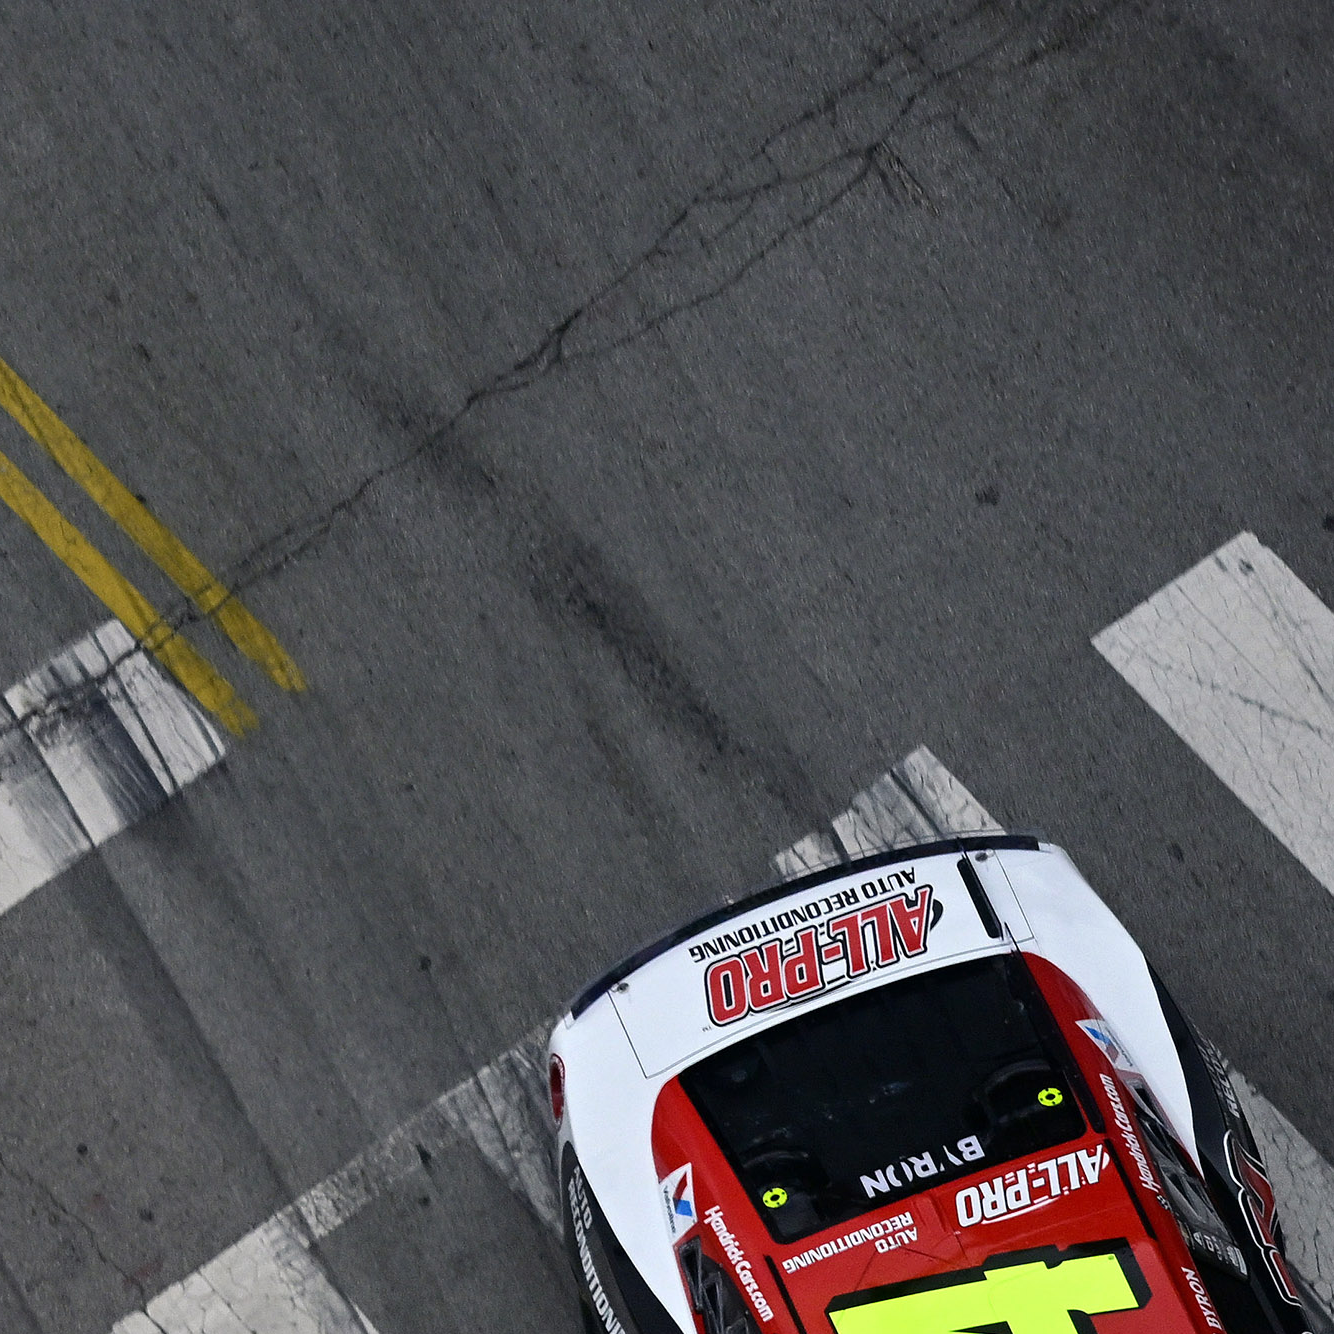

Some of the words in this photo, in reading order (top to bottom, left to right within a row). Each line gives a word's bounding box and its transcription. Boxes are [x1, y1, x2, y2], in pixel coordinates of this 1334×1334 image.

[861, 867, 916, 899] AUTO
[688, 888, 860, 963] RECONDITIONING
[704, 884, 937, 1027] ALL-PRO
[1099, 1073, 1161, 1193] HendrickCars.com
[574, 1166, 593, 1229] AUTO
[860, 1134, 986, 1199] BYRON
[955, 1144, 1110, 1228] ALL-PRO
[704, 1205, 775, 1322] HendrickCars.com
[781, 1211, 914, 1274] RECONDITIONING
[875, 1227, 918, 1254] AUTO
[1180, 1266, 1223, 1329] BYRON
